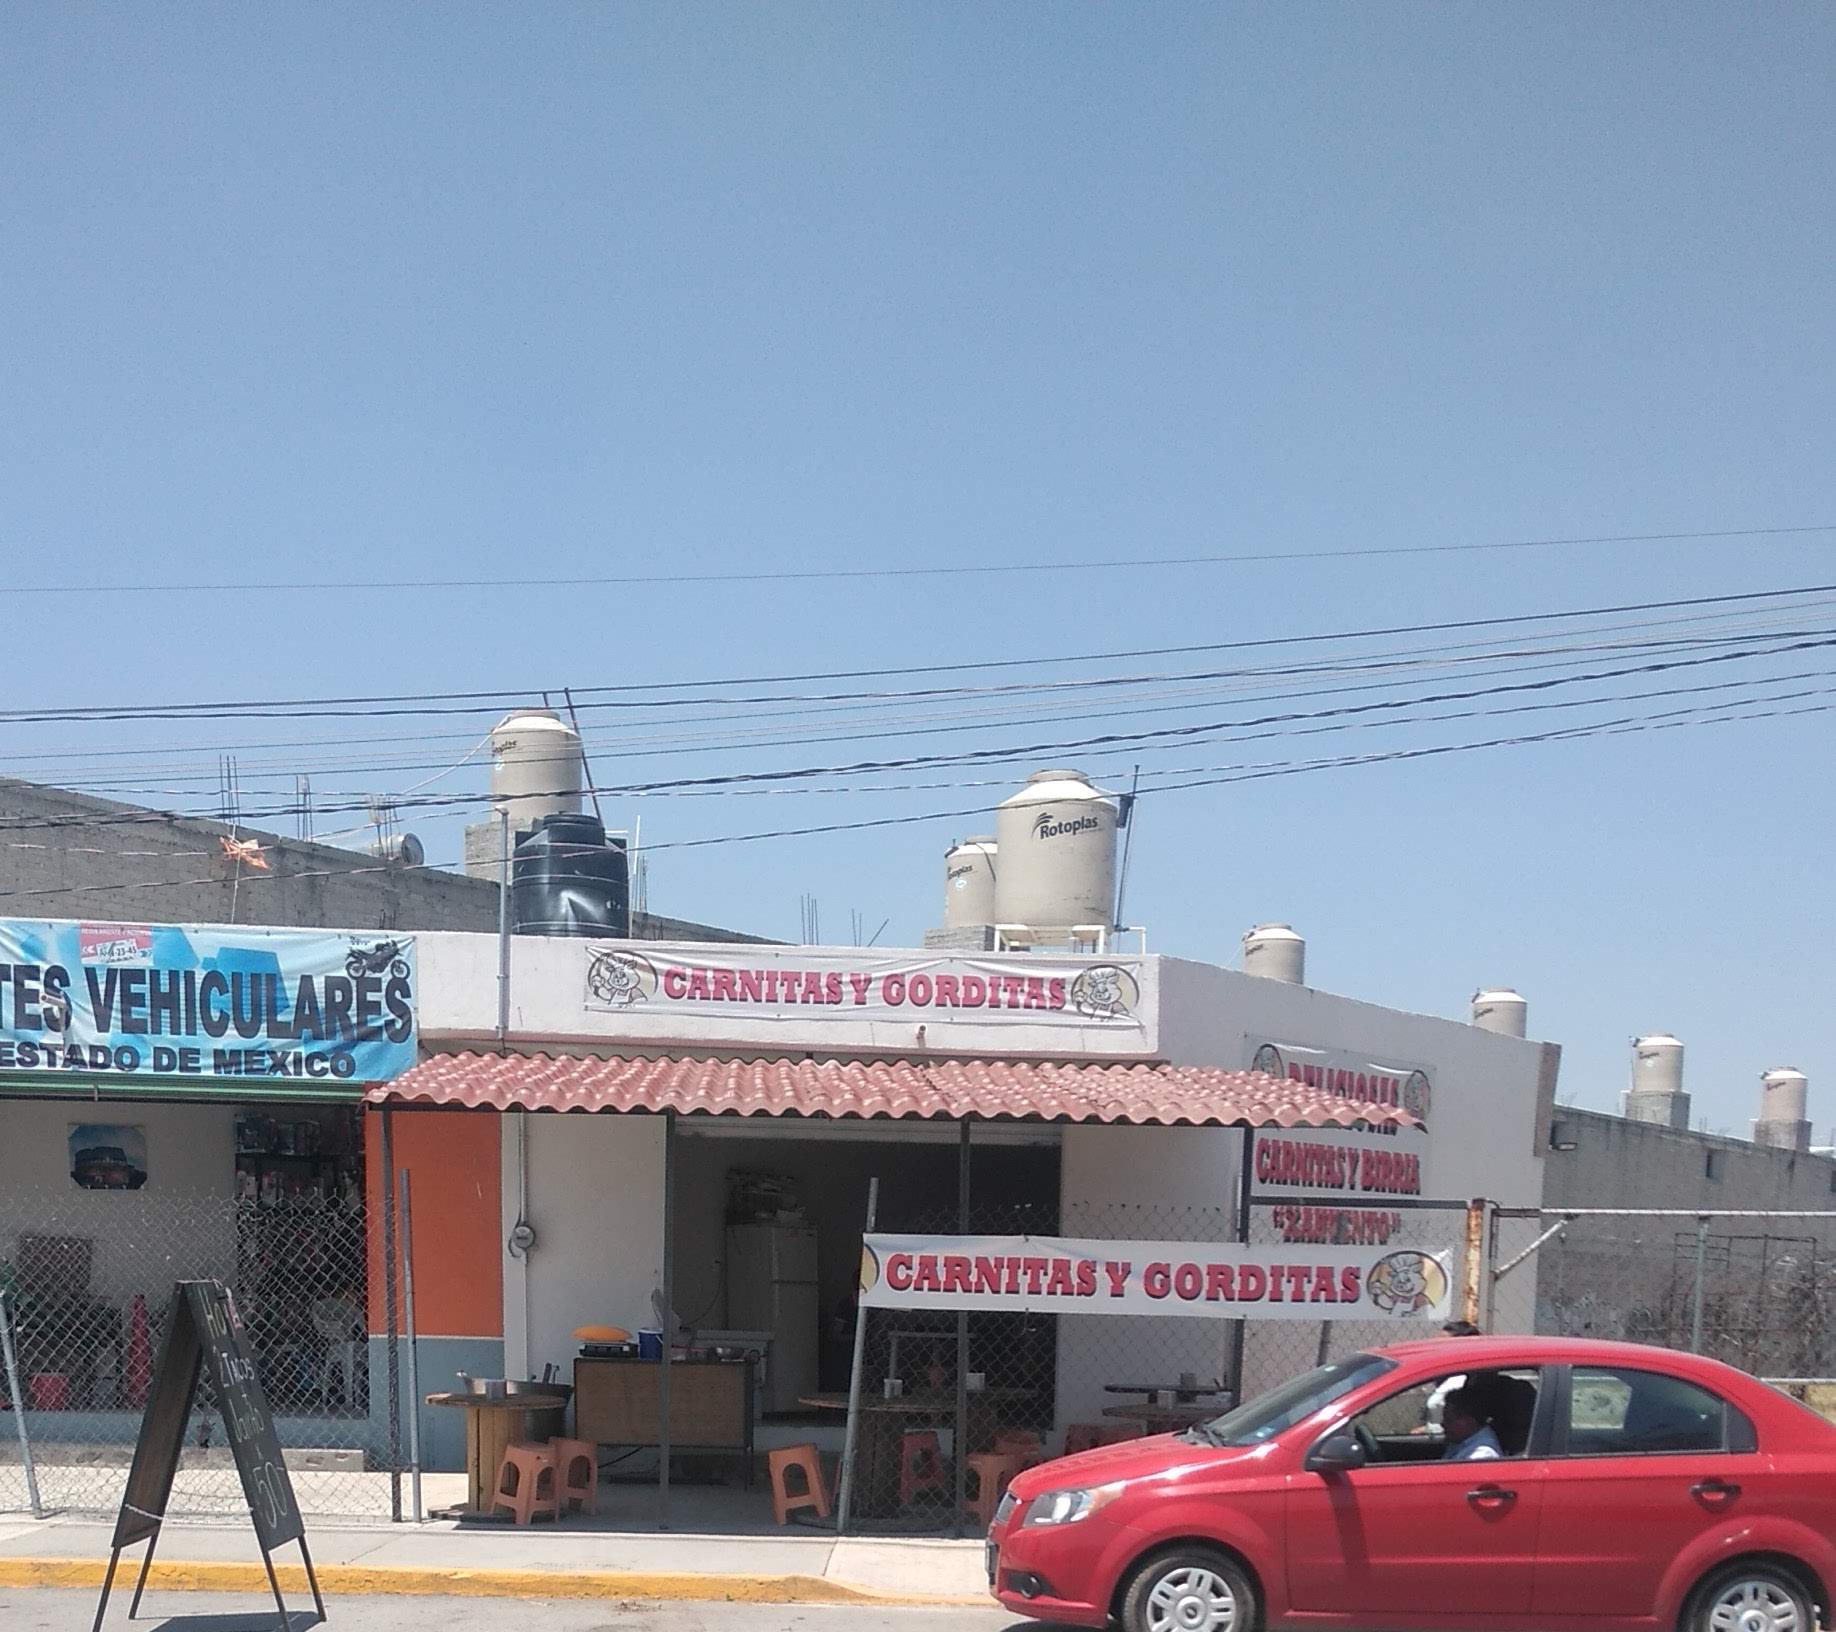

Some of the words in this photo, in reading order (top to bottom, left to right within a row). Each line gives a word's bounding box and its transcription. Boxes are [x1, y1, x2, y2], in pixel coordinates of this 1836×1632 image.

[1040, 816, 1098, 839] Rotoplas
[84, 966, 413, 1044] VEHICULARES
[664, 966, 842, 1007] CARNITAS
[849, 973, 871, 1006] Y
[883, 973, 1067, 1012] GORDITAS
[0, 1040, 140, 1072] ESTADO
[153, 1046, 202, 1073] DE
[213, 1049, 357, 1078] MEXICO
[1256, 1137, 1346, 1189] CARNITAS
[1347, 1147, 1360, 1191] Y
[1360, 1148, 1421, 1196] BIRRIA
[886, 1253, 1097, 1297] CARNITAS
[1105, 1261, 1132, 1298] Y
[1143, 1262, 1361, 1304] GORDITAS
